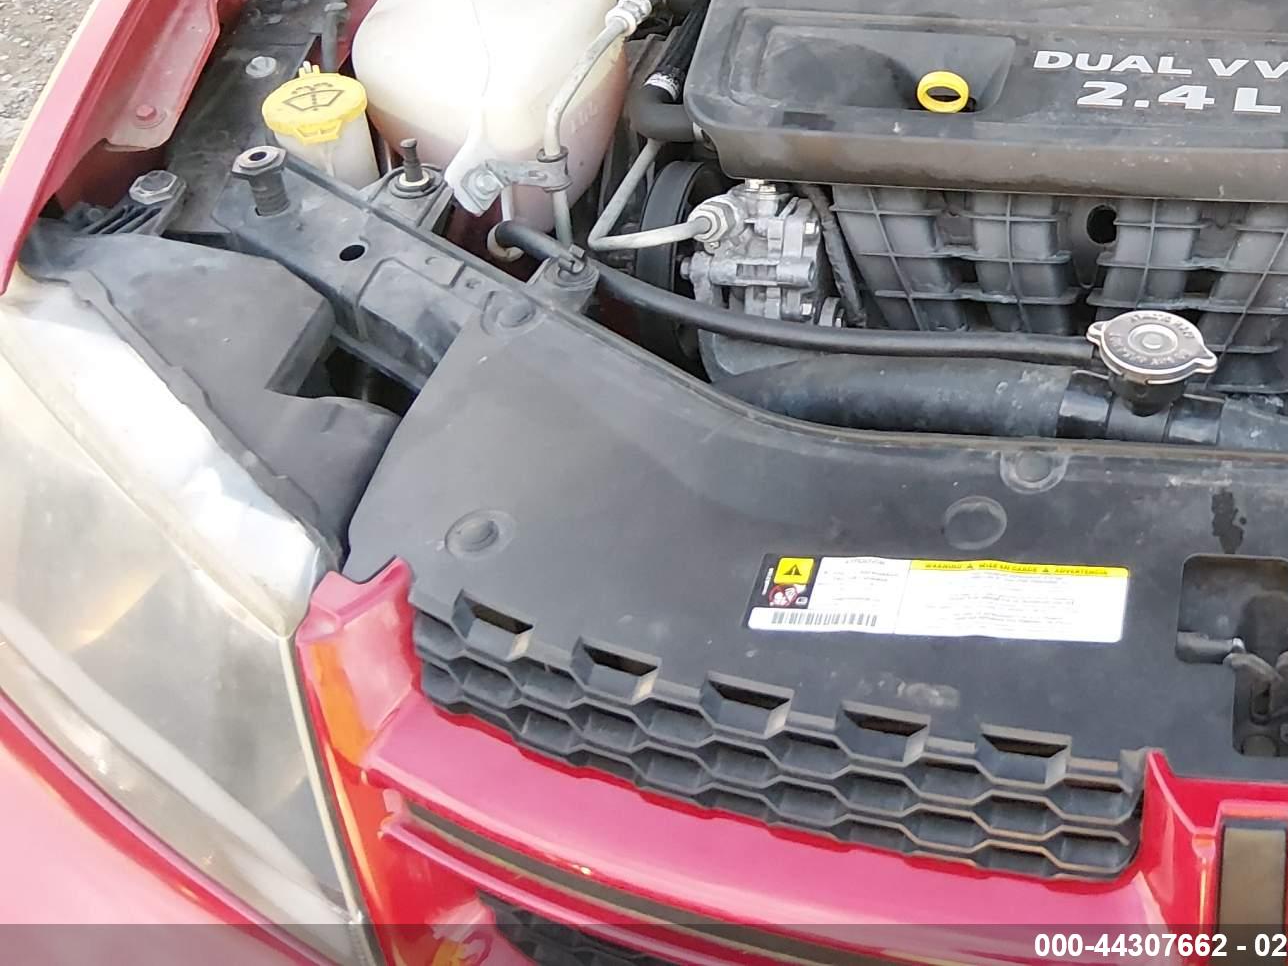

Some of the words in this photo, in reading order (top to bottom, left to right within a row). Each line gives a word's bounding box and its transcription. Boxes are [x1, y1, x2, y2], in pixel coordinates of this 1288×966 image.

[1033, 49, 1193, 76] DUAL
[1076, 80, 1216, 111] 2.4
[1232, 86, 1283, 115] L
